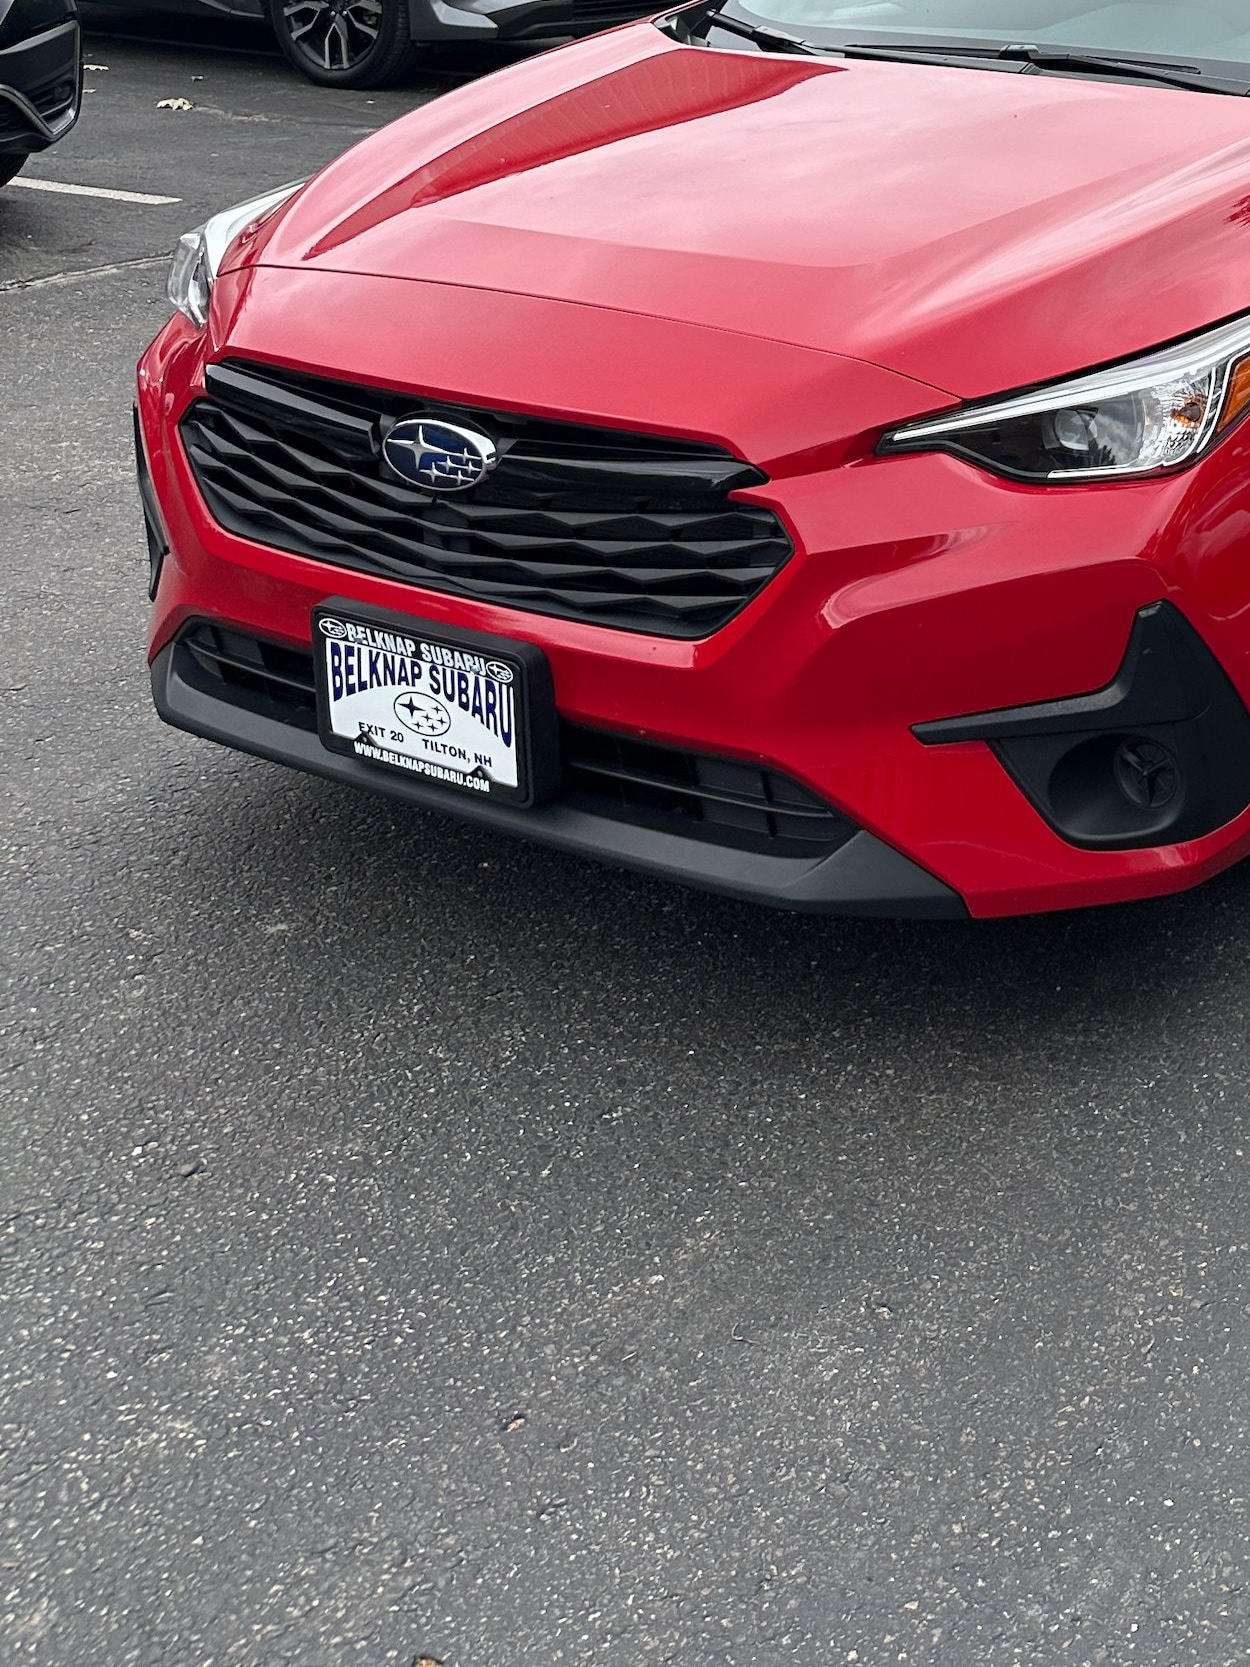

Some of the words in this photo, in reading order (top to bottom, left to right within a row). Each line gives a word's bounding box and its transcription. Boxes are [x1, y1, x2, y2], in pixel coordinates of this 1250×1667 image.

[346, 622, 416, 658] BELKNAP
[421, 642, 487, 677] SUBARU
[330, 641, 423, 702] BELKNAP
[428, 663, 513, 748] SUBARU
[357, 721, 386, 739] EXIT
[390, 730, 405, 744] 20
[422, 738, 471, 764] TILTON,
[474, 752, 493, 768] NH
[353, 741, 491, 793] WWW.BELKNAPSUBARU.COM
